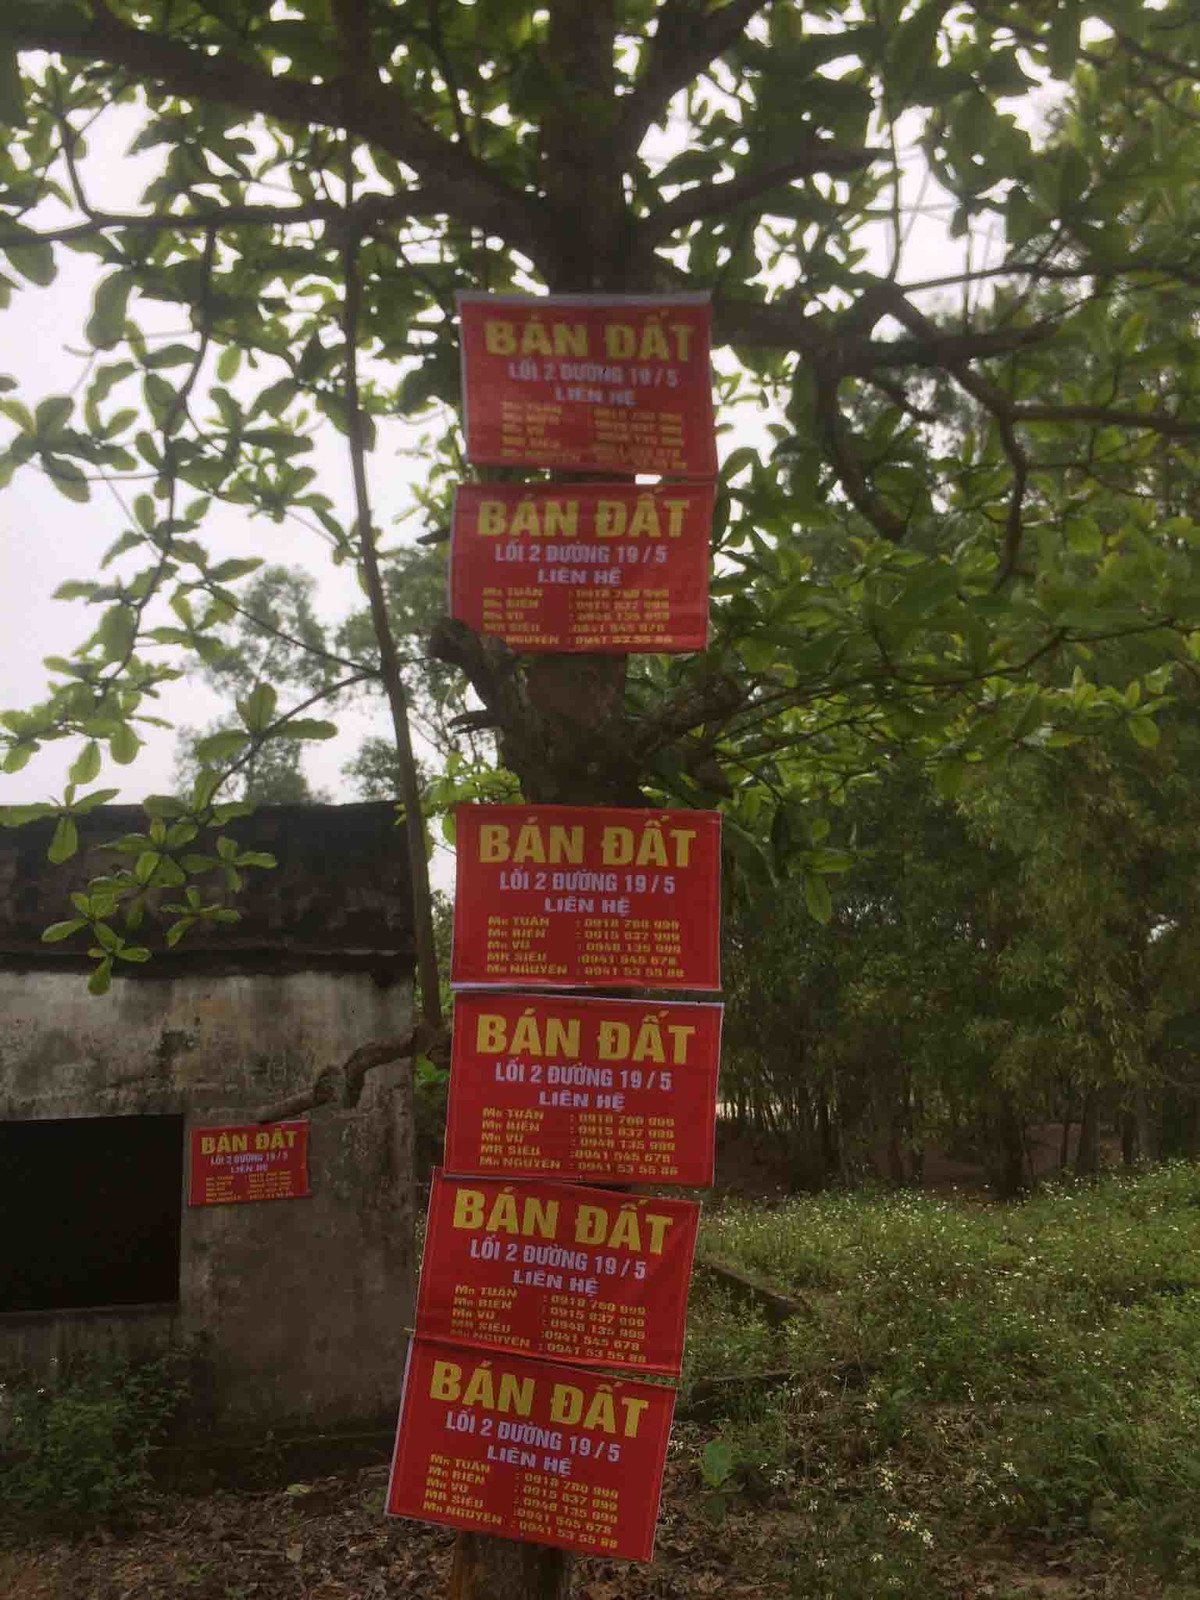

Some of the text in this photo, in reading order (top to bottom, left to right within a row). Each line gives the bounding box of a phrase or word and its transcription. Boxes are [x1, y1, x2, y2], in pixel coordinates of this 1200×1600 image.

[484, 309, 695, 362] BÁN ĐẤT
[478, 488, 690, 537] BÁN ĐẤT
[528, 545, 540, 563] 2
[618, 546, 638, 563] 19
[655, 546, 667, 563] 5
[538, 566, 587, 584] LIÊN
[479, 815, 697, 867] BÁN ĐẤT
[535, 872, 546, 890] 2
[552, 868, 616, 891] ĐƯỜNG
[624, 874, 646, 892] 19
[664, 876, 675, 893] 5
[544, 896, 629, 916] LIÊN HỆ
[475, 1007, 695, 1064] BÁN ĐẤT
[530, 1064, 542, 1082] 2
[547, 1061, 612, 1086] ĐƯỜNG
[620, 1070, 642, 1088] 19
[660, 1072, 671, 1090] 5
[539, 1089, 624, 1112] LIÊN HỆ
[255, 1127, 297, 1150] ĐẤT
[452, 1186, 673, 1254] BÁN ĐẤT
[505, 1243, 517, 1261] 2
[522, 1244, 587, 1271] ĐƯỜNG
[595, 1255, 617, 1274] 19
[634, 1260, 646, 1279] 5
[512, 1269, 598, 1297] LIÊN HỆ
[429, 1359, 649, 1438] BÁN ĐẤT
[480, 1417, 492, 1436] 2
[497, 1420, 562, 1450] ĐƯỜNG
[569, 1435, 591, 1455] 19
[608, 1443, 620, 1462] 5
[486, 1444, 571, 1477] LIÊN HỆ
